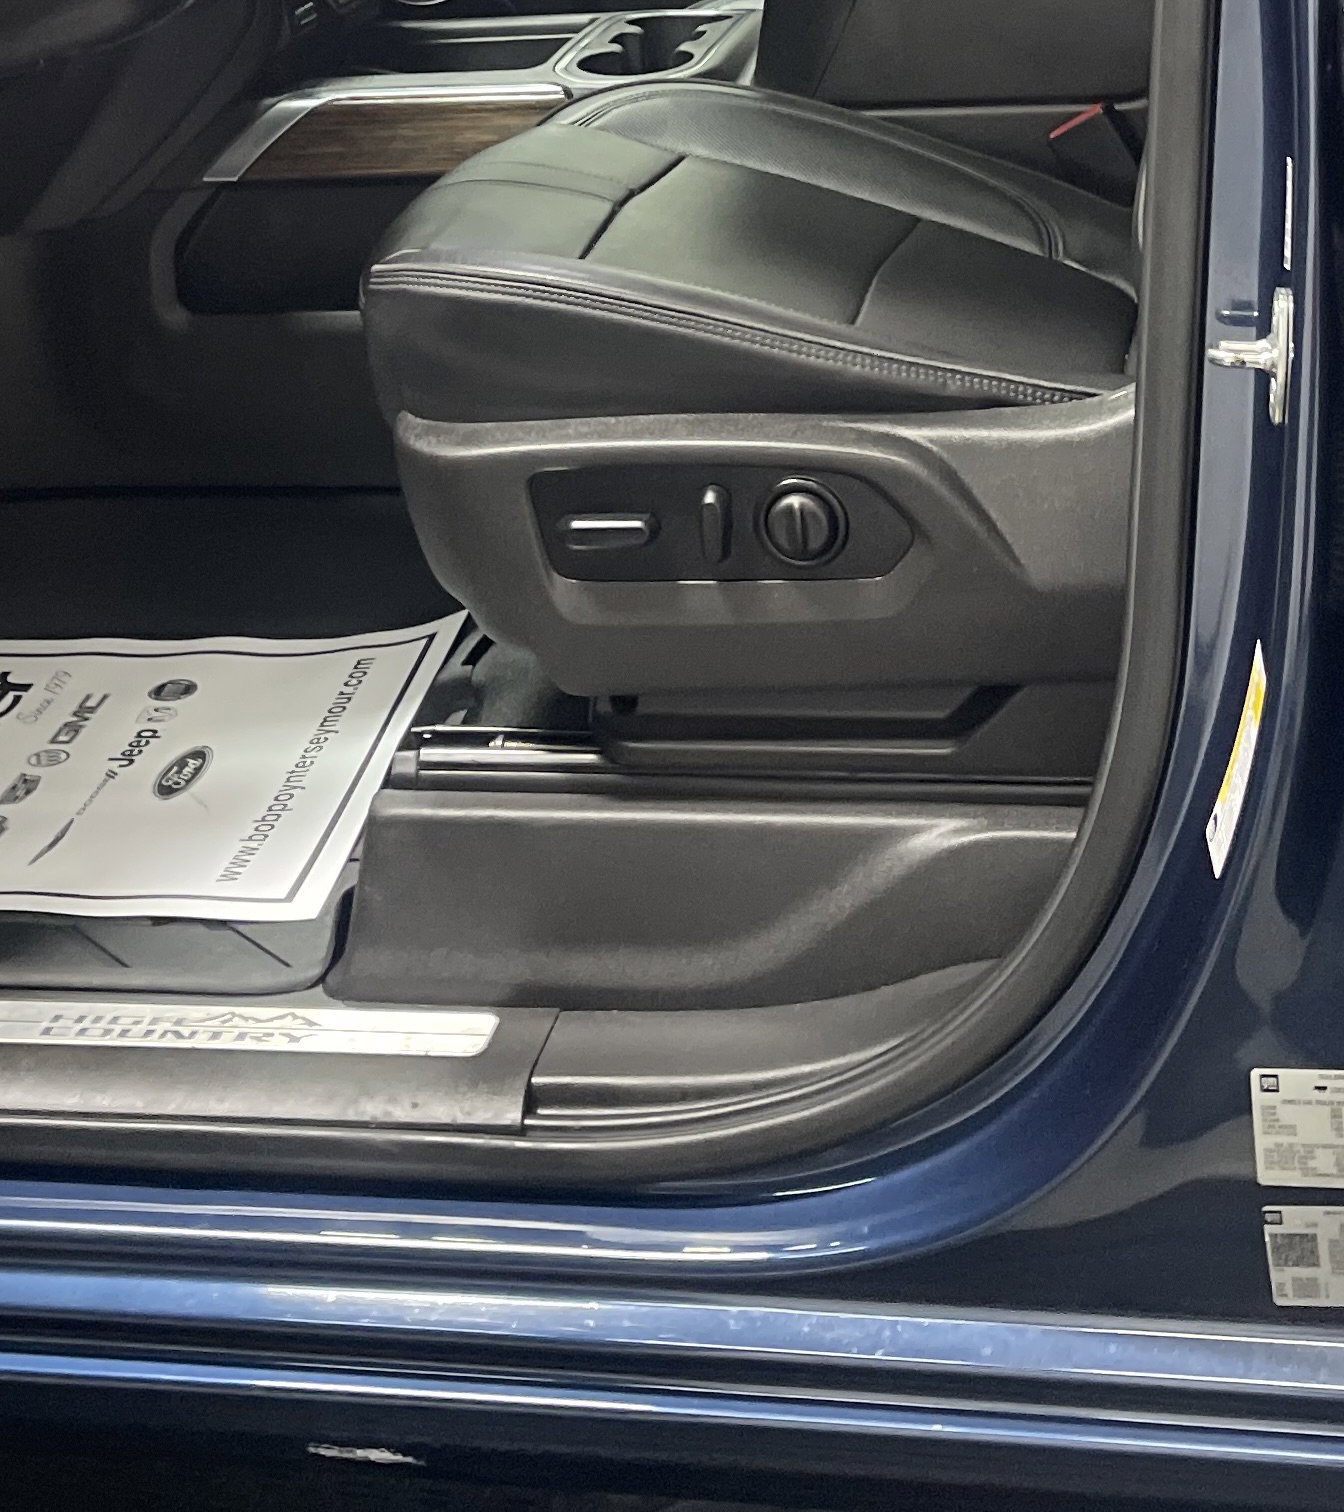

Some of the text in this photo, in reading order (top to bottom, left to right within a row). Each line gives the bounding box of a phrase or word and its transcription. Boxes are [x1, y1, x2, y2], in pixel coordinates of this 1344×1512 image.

[48, 693, 112, 745] GMC
[108, 728, 161, 768] Jeep
[161, 756, 203, 789] Ford
[216, 657, 376, 883] www.bobpoynterseymour.com
[40, 1026, 318, 1044] COUNTRY
[49, 1014, 186, 1027] HIGH
